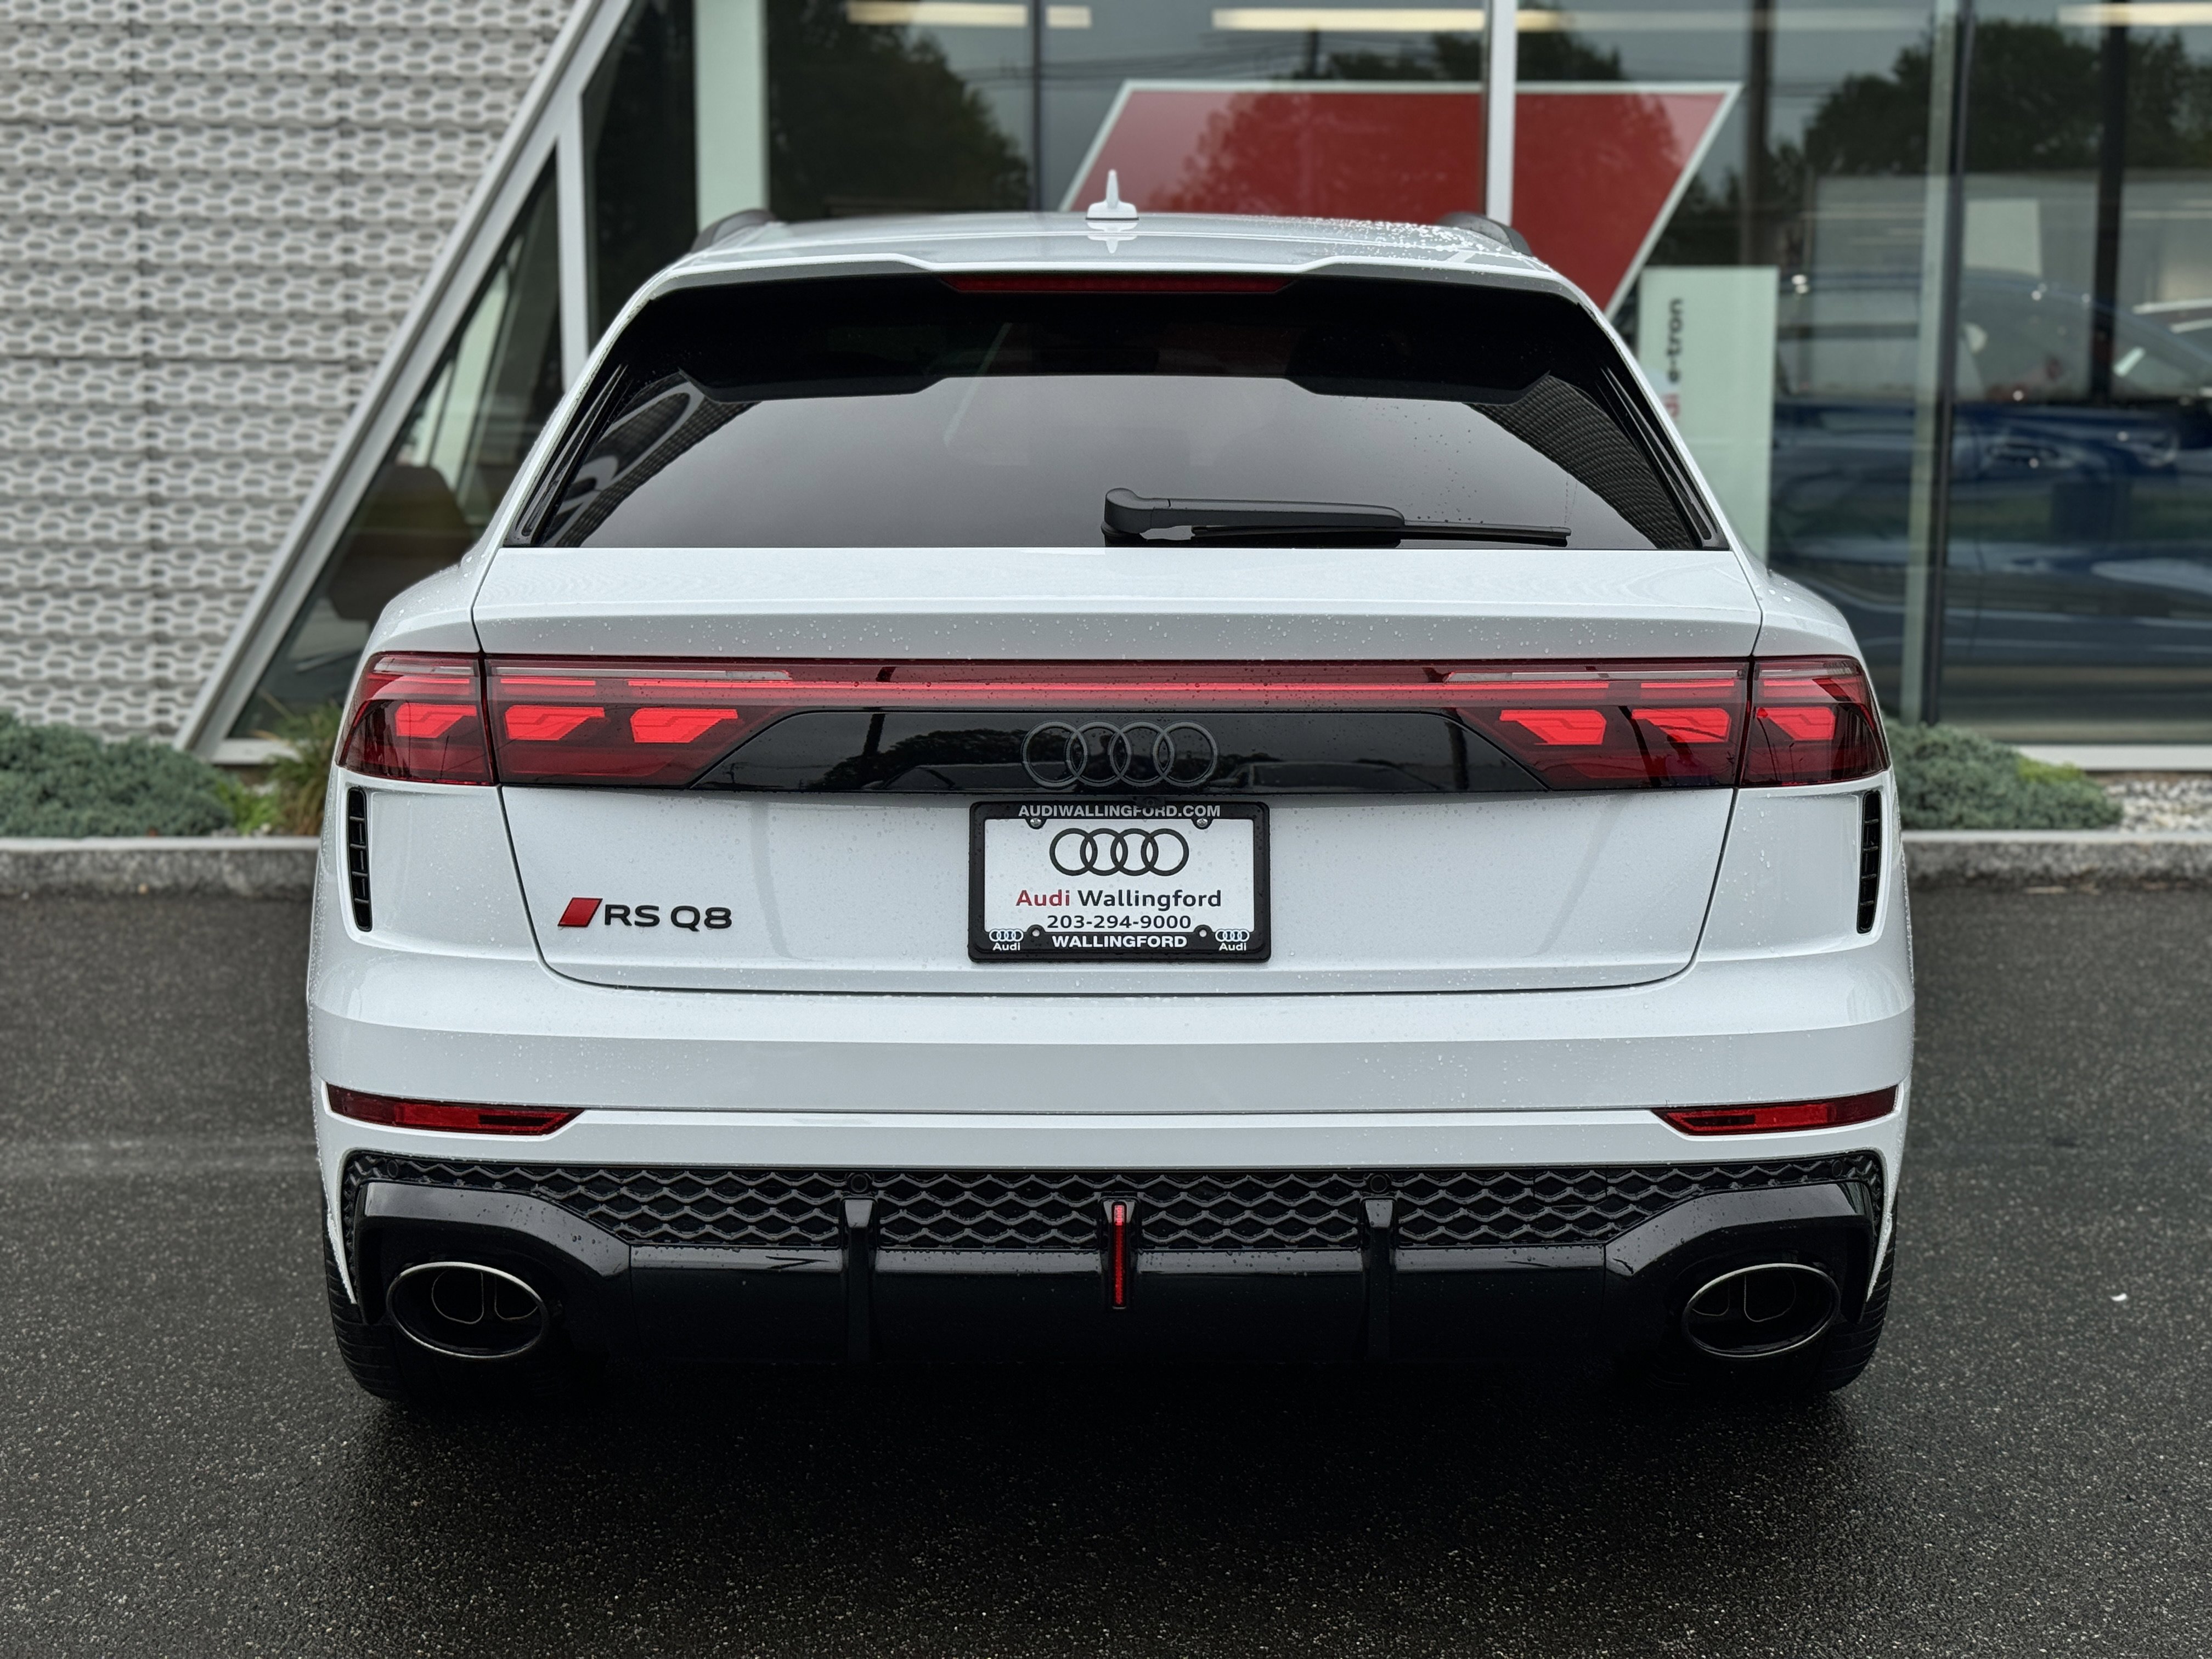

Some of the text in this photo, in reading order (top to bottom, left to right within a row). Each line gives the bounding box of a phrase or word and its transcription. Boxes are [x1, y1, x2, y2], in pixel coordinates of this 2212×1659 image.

[1018, 805, 1221, 817] AUDIWALLINGFORD.COM
[1015, 889, 1221, 911] Audi Wallingford
[605, 904, 732, 933] RS Q8
[1047, 915, 1191, 929] 203-294-9000
[992, 942, 1021, 951] Audi
[1052, 935, 1188, 948] WALLINGFORD
[1218, 942, 1247, 951] Audi
